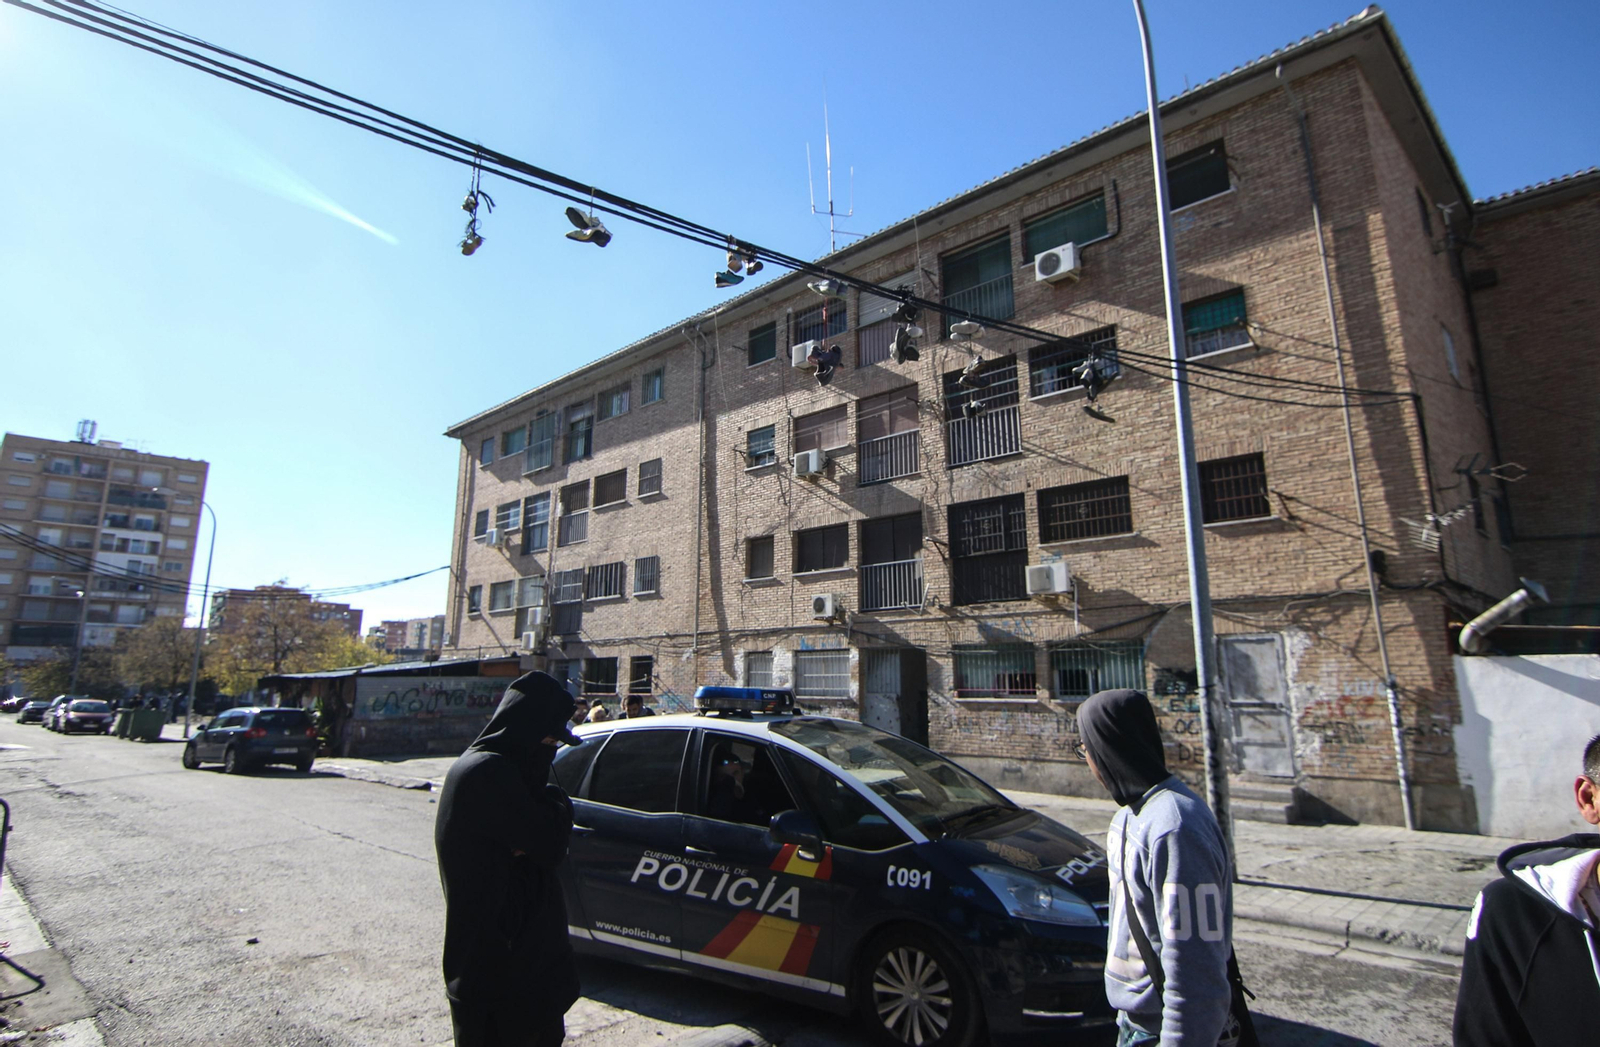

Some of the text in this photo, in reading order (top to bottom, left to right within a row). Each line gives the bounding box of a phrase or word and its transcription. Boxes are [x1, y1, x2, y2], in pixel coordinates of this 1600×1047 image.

[643, 849, 750, 877] CUERPO NACIONAL DE
[630, 856, 801, 919] POLICÍA
[595, 921, 672, 944] www.policia.es
